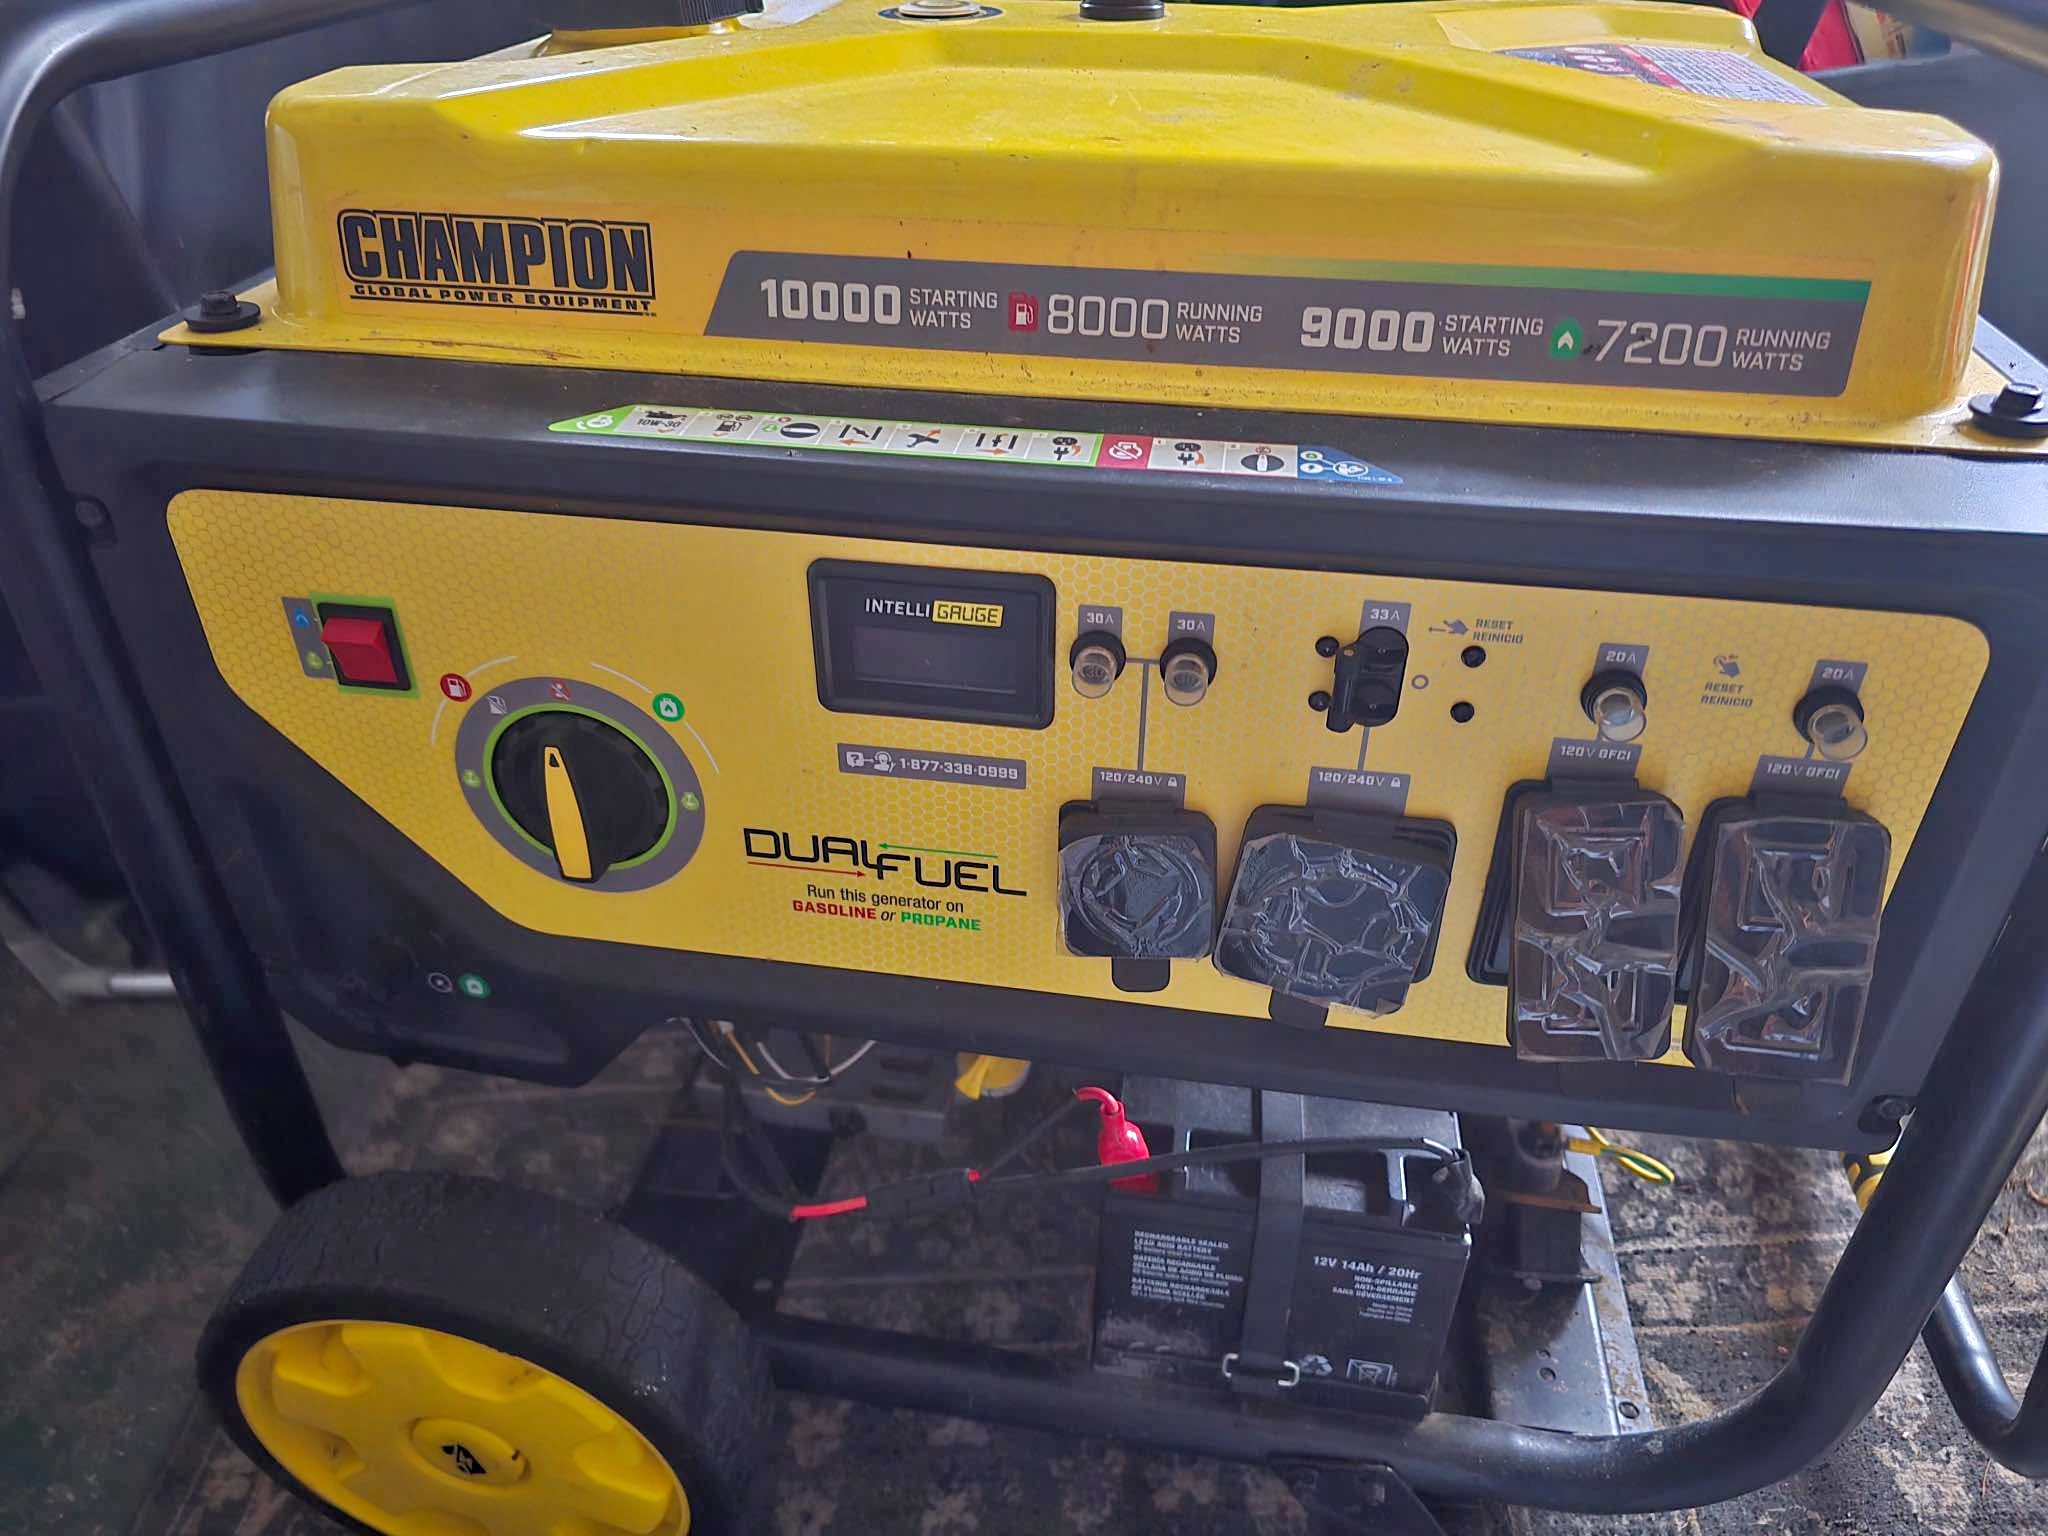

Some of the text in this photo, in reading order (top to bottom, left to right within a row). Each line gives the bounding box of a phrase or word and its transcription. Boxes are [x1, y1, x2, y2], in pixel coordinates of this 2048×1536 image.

[341, 214, 649, 293] CHAMPION
[354, 284, 651, 312] GLOBAL POWER EQUIPMENT
[760, 278, 998, 326] 10000 STARTING
[909, 309, 972, 329] WATTS
[1047, 293, 1262, 341] 8000 RUNNING
[1175, 323, 1241, 344] WATTS
[1300, 306, 1544, 353] 9000 STARTING
[1442, 336, 1511, 358] WATTS
[1594, 319, 1831, 368] 7200 RUNNING
[1731, 350, 1804, 373] WATTS
[864, 598, 999, 624] INTELLI GAUGE
[1086, 612, 1115, 625] 30A
[1369, 608, 1401, 621] 33A
[1176, 618, 1206, 632] 30A
[1475, 618, 1515, 630] RESET
[1605, 650, 1637, 664] 20A
[1821, 667, 1854, 681] 20A
[1703, 681, 1744, 694] RESET
[1560, 745, 1595, 758] 120V
[1100, 771, 1162, 787] 120/240V
[1317, 770, 1385, 787] 120/240V
[1767, 763, 1803, 776] 120V
[806, 884, 964, 913] Run this generator on
[792, 900, 981, 931] GASOLINE or PROPANE
[1313, 1255, 1338, 1268] 12V
[1341, 1260, 1374, 1273] 14Ah
[1388, 1266, 1423, 1279] 20Hr
